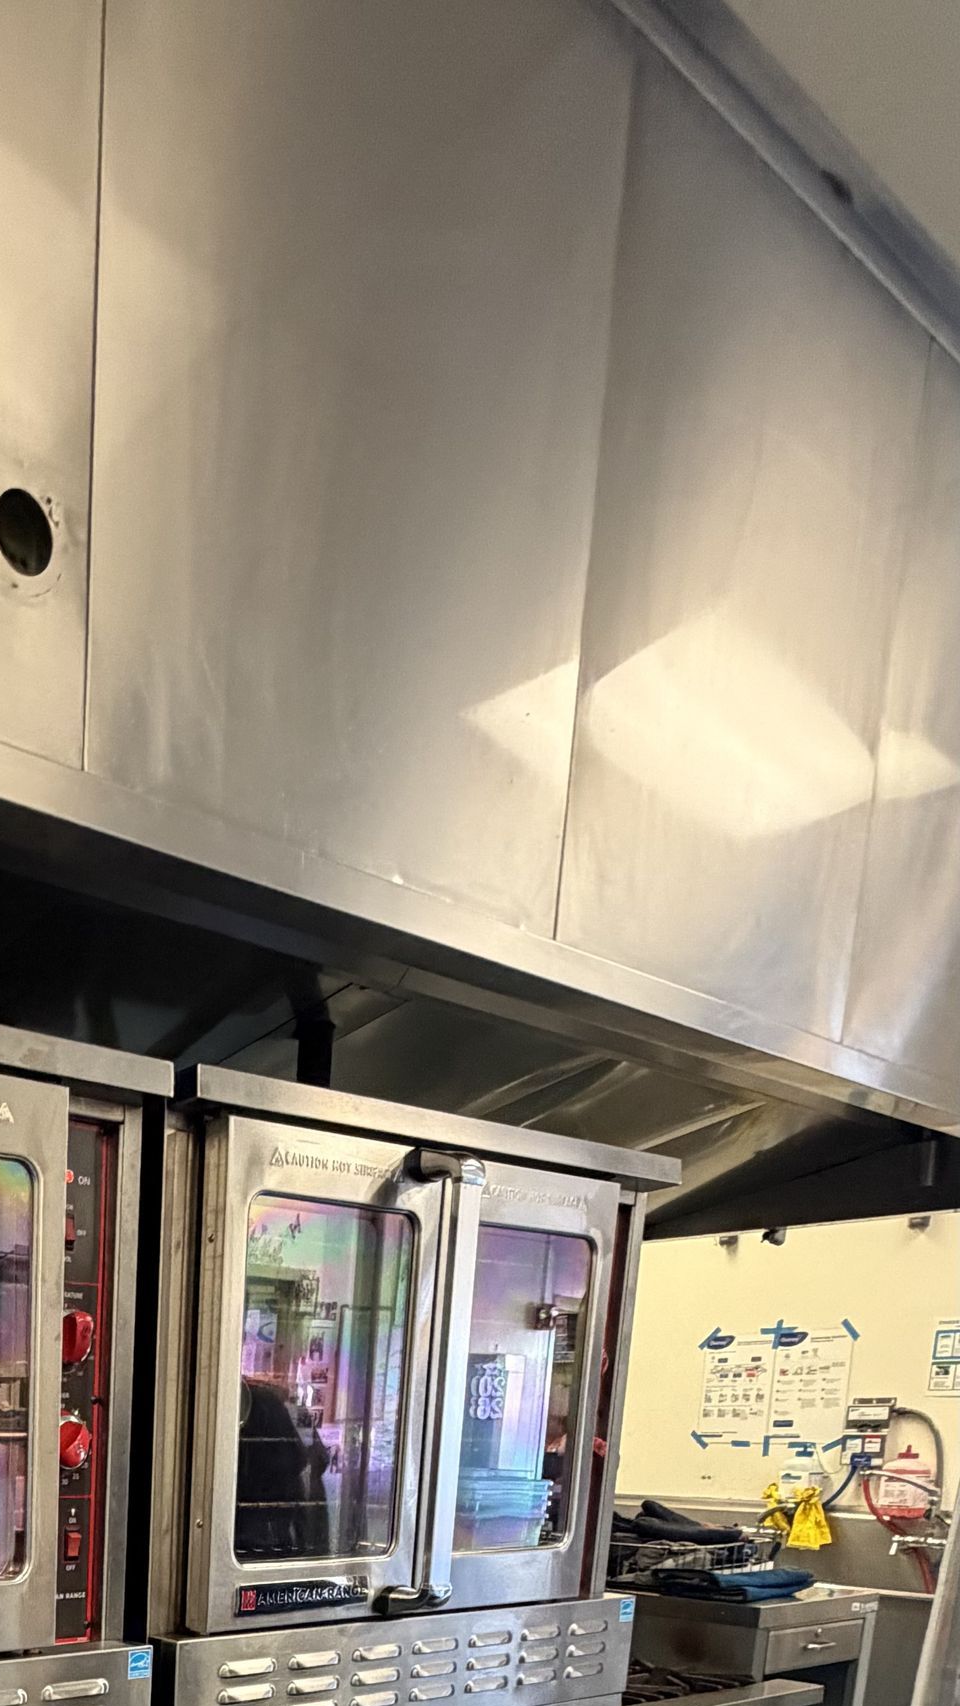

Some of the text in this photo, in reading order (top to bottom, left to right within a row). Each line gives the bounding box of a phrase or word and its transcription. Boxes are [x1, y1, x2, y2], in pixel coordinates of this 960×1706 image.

[284, 1150, 329, 1171] CAUTION
[331, 1159, 351, 1174] HOT
[77, 1175, 91, 1186] ON
[65, 1591, 86, 1600] RANGE
[257, 1584, 367, 1606] AMERICAN RANGE
